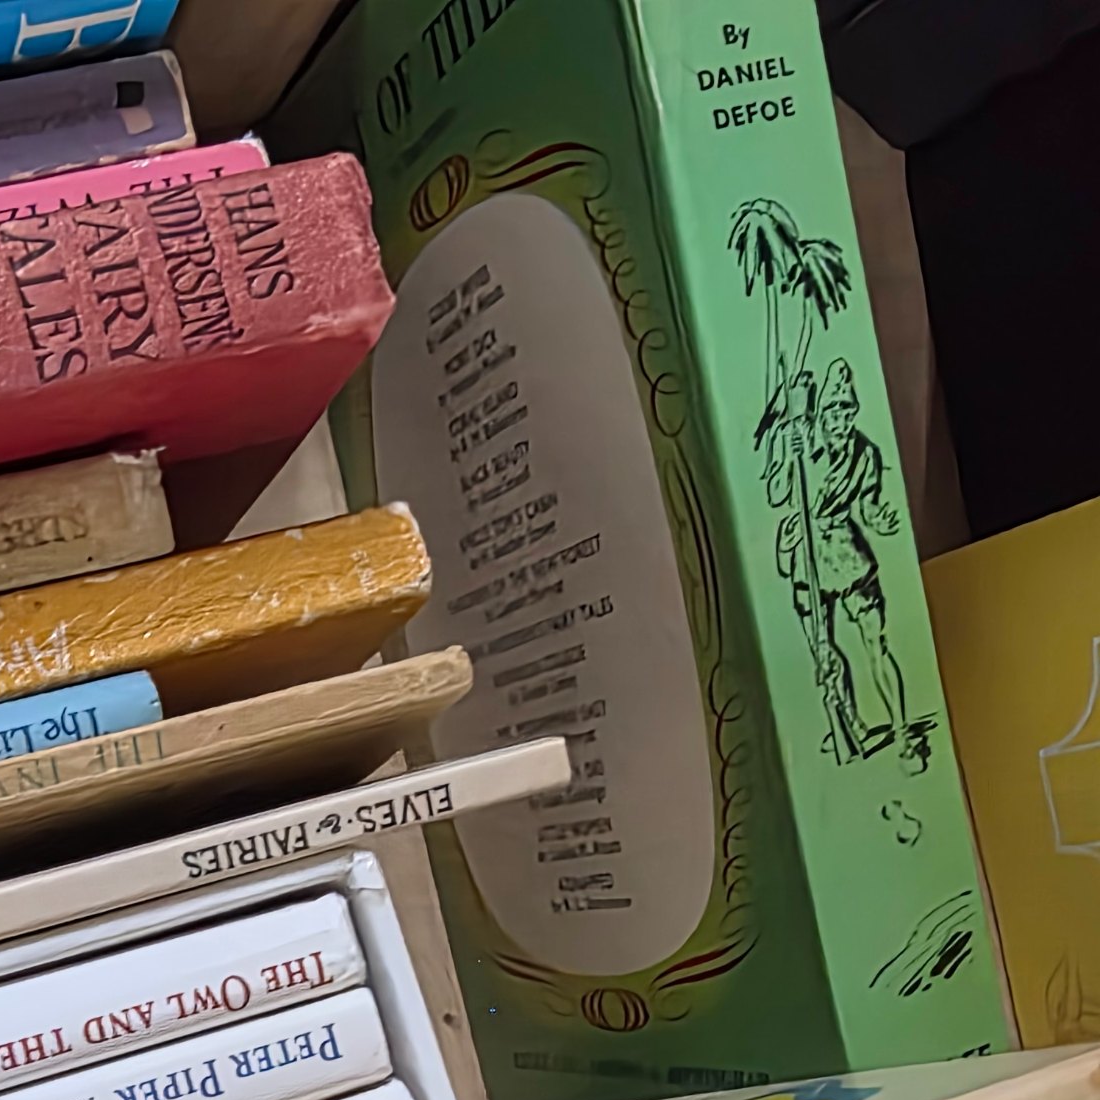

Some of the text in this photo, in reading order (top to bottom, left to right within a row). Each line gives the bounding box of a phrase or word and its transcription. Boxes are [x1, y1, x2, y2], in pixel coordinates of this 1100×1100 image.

[723, 24, 750, 50] By
[697, 56, 796, 92] DANIEL
[713, 96, 797, 130] DEFOE
[221, 182, 295, 303] HANS
[44, 706, 106, 743] The
[181, 820, 308, 880] FAIRIES
[260, 951, 334, 997] THE
[167, 974, 251, 1020] OWL
[84, 1000, 156, 1042] AND
[229, 1022, 344, 1076] PETER
